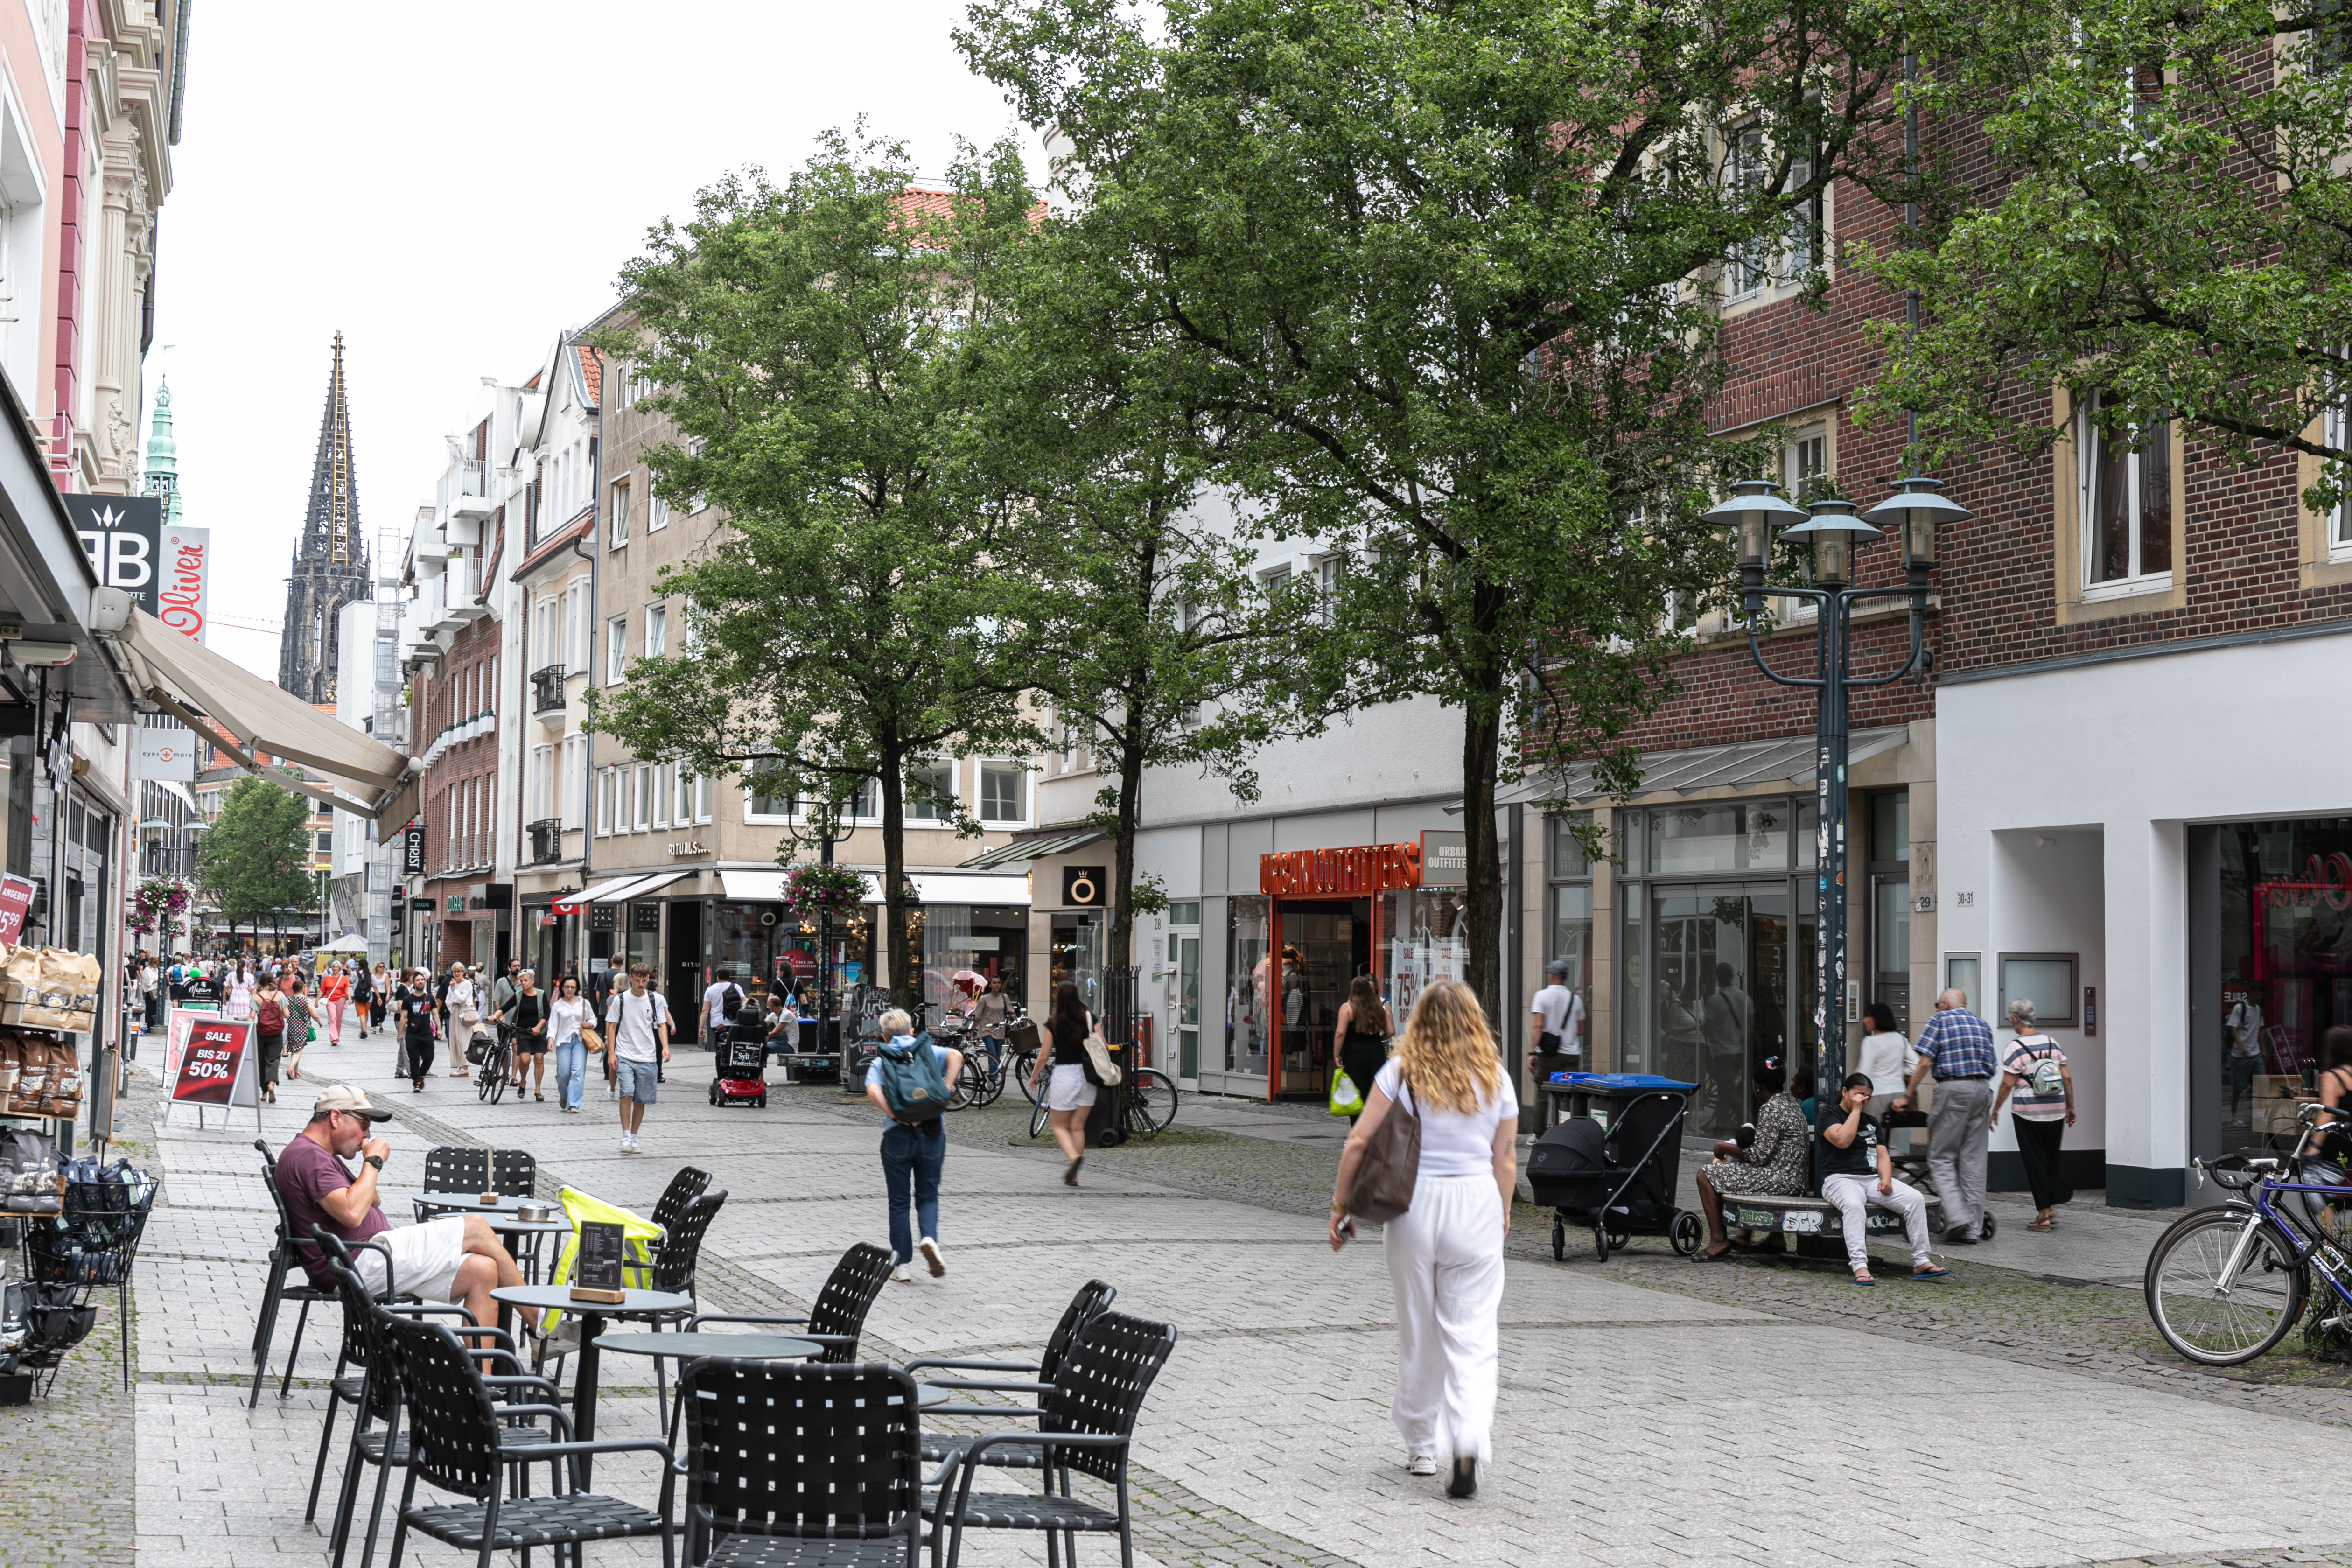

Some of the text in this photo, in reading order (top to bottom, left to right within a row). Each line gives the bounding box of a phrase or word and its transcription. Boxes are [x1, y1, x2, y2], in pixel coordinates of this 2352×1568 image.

[409, 832, 420, 868] CHRIST
[1439, 846, 1466, 857] URBAN
[1260, 842, 1417, 896] URBAN OUTFITTERS
[1428, 857, 1467, 869] OUTFITTE
[2, 888, 28, 903] ANGEBOT
[1958, 893, 1973, 904] 30-31
[448, 896, 463, 912] DOUGLAS
[1920, 897, 1930, 907] 29
[1154, 918, 1161, 930] 28
[1403, 948, 1413, 959] SALE
[1441, 948, 1451, 959] SALE
[1397, 973, 1419, 1007] 75%
[205, 1031, 232, 1042] SALE
[196, 1049, 231, 1061] BIS ZU
[738, 1052, 750, 1061] Sylt
[189, 1061, 228, 1079] 50%
